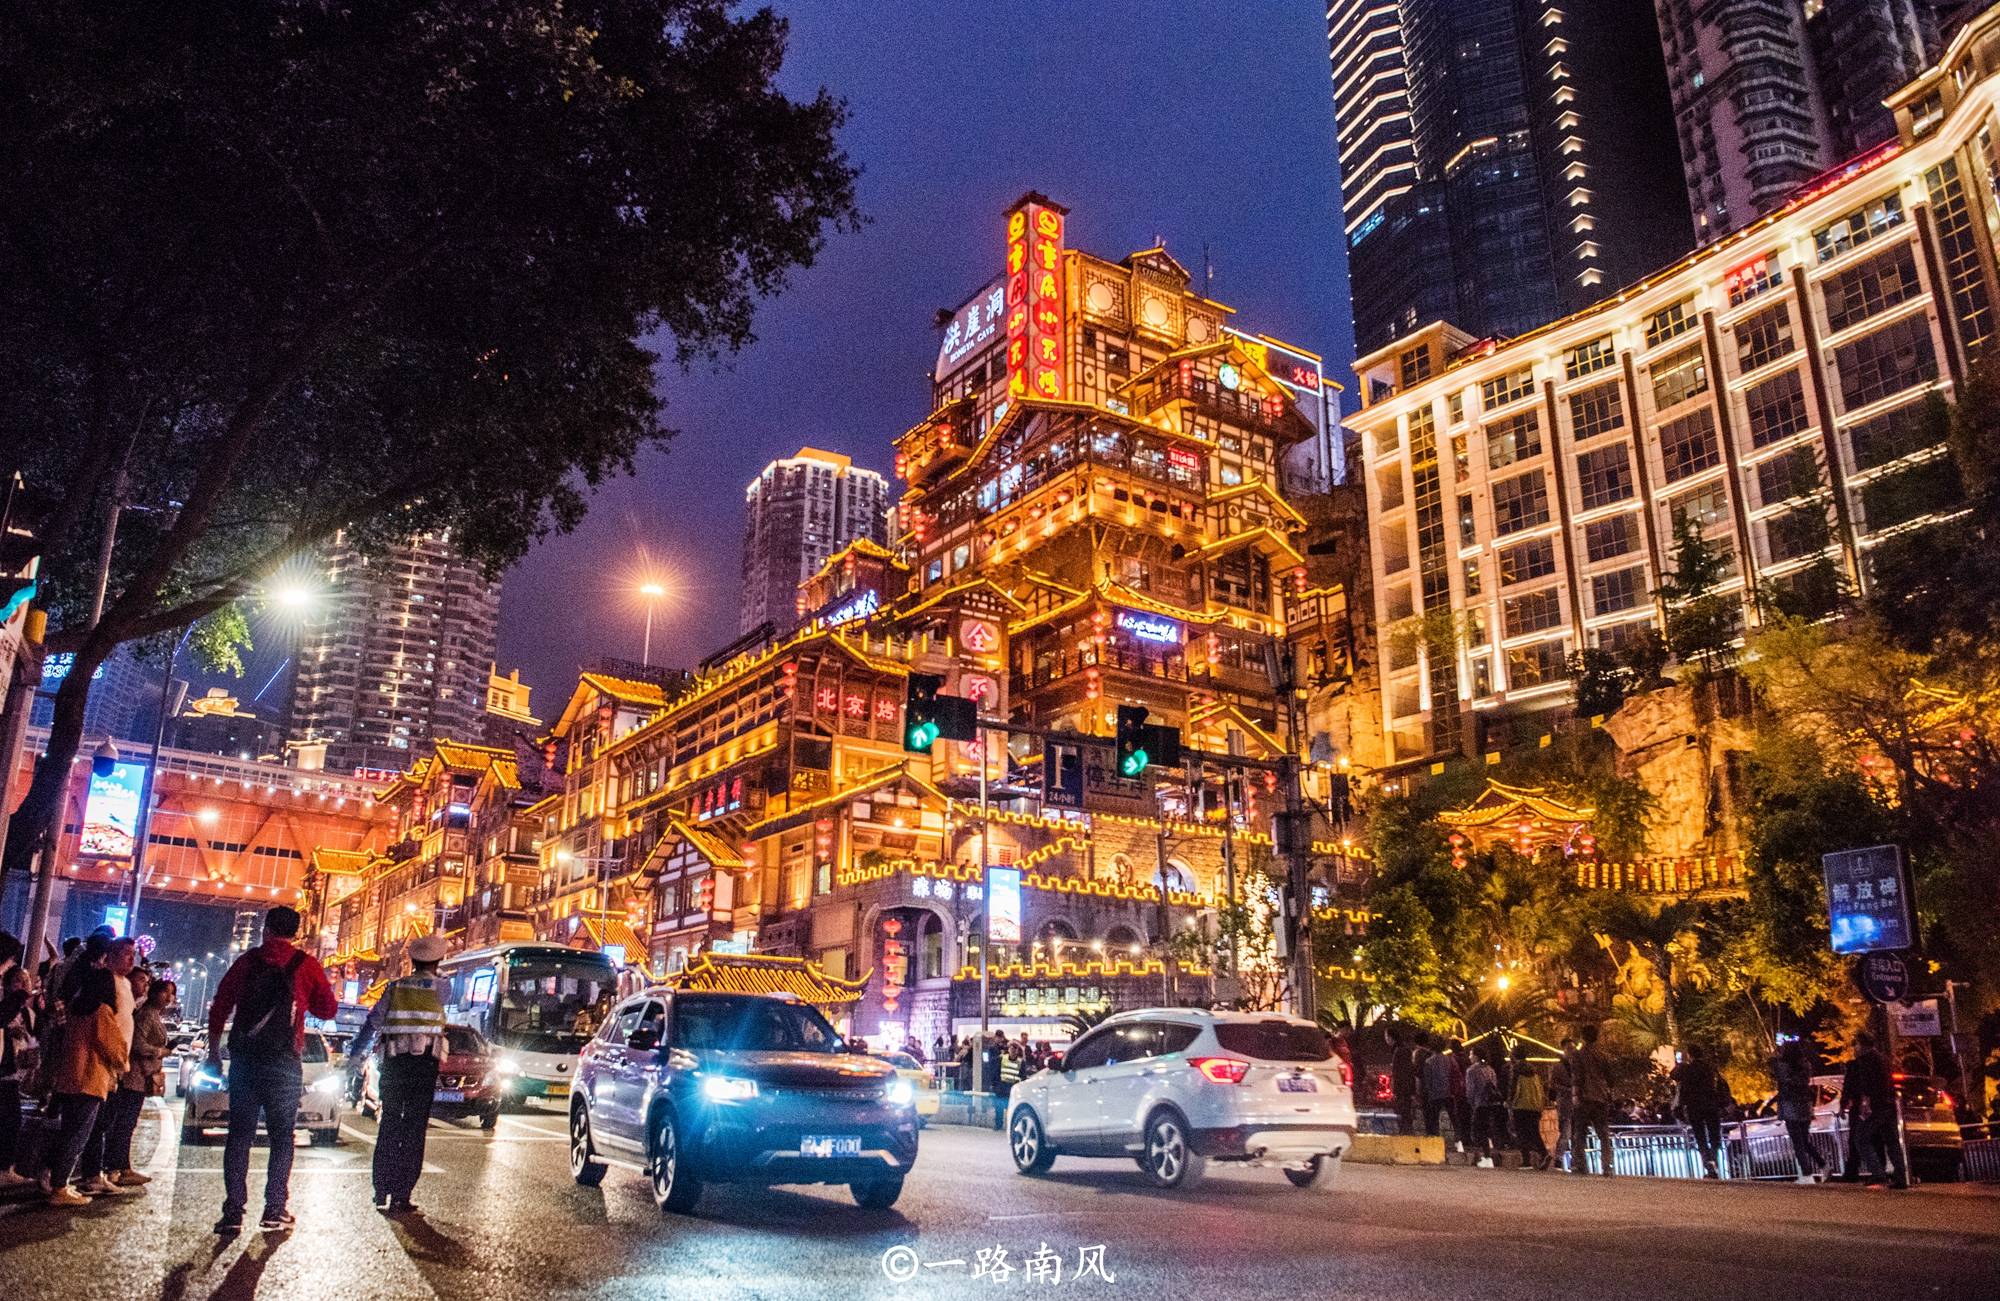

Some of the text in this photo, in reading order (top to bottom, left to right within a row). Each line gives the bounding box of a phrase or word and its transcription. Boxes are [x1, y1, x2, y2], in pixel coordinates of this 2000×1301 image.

[944, 287, 1004, 354] 洪崖洞
[950, 323, 996, 364] HONGYA CAVE
[1293, 366, 1319, 389] 火锅
[1833, 876, 1898, 902] 解放碑
